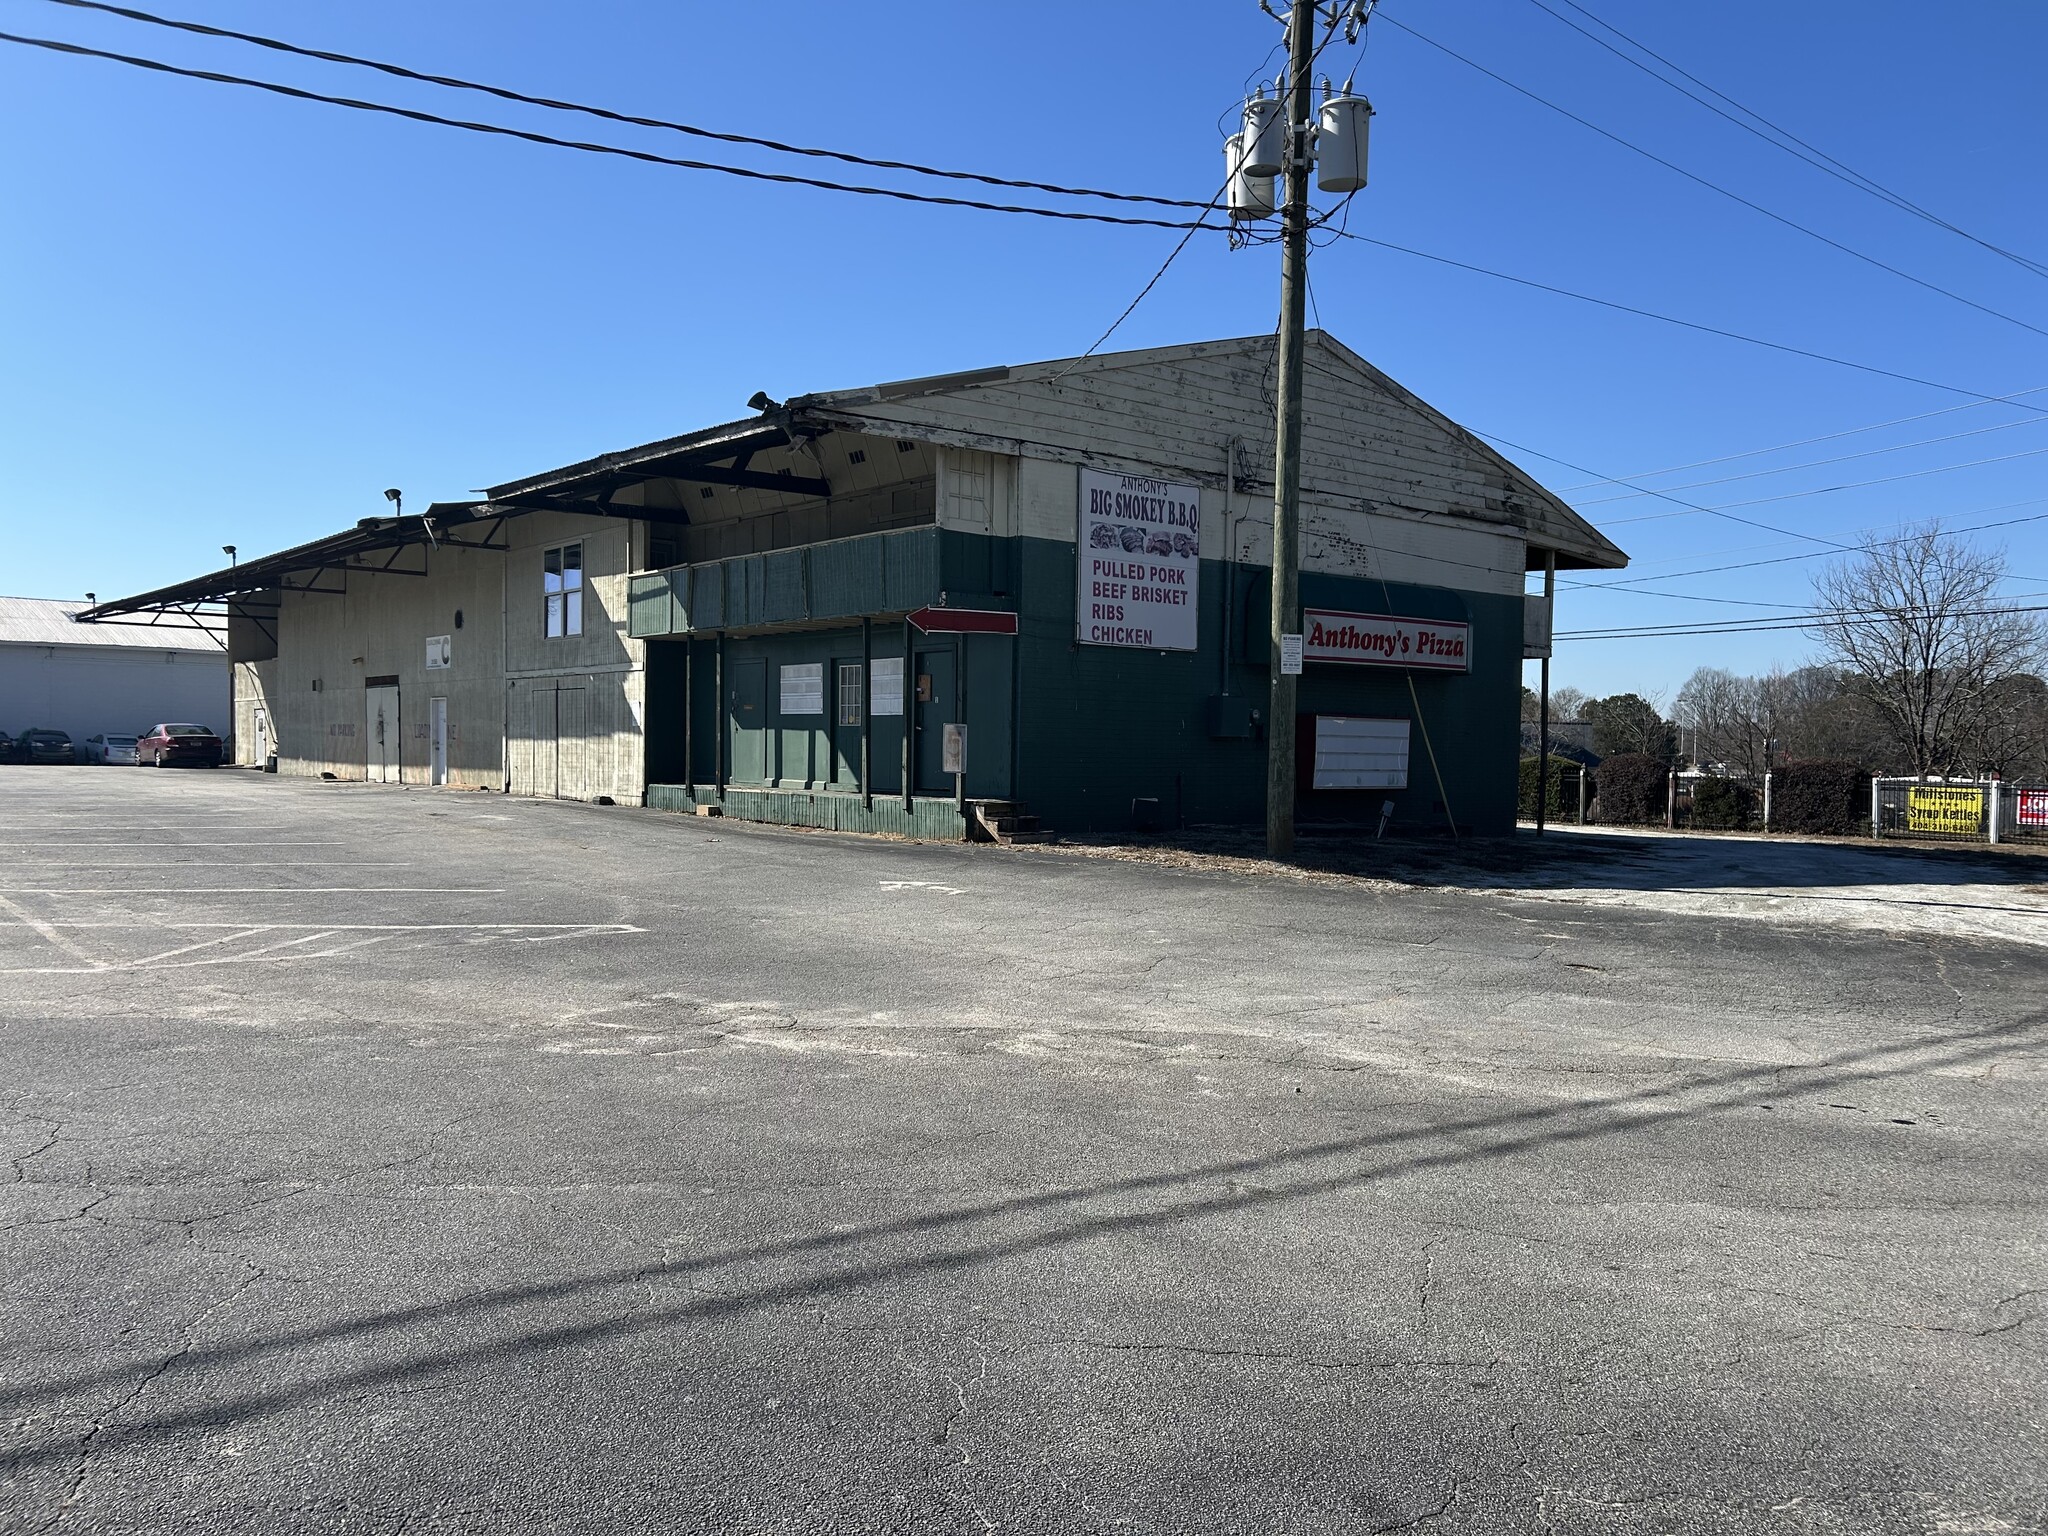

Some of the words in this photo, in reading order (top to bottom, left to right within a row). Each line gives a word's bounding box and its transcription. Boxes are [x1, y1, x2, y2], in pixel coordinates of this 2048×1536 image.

[1121, 476, 1168, 496] ANTHONY'S
[1090, 488, 1113, 516] BIG
[1115, 492, 1166, 523] SMOKEY
[1093, 559, 1145, 581] PULLED
[1150, 566, 1185, 585] PORK
[1092, 581, 1127, 600] BEEF
[1132, 585, 1188, 606] BRISKET
[1092, 603, 1124, 621] RIBS
[1091, 625, 1153, 645] CHICKEN
[1307, 622, 1410, 658] Anthony's
[1416, 631, 1464, 658] Pizza
[1910, 806, 1939, 820] Syrup
[1942, 807, 1980, 821] Kettles
